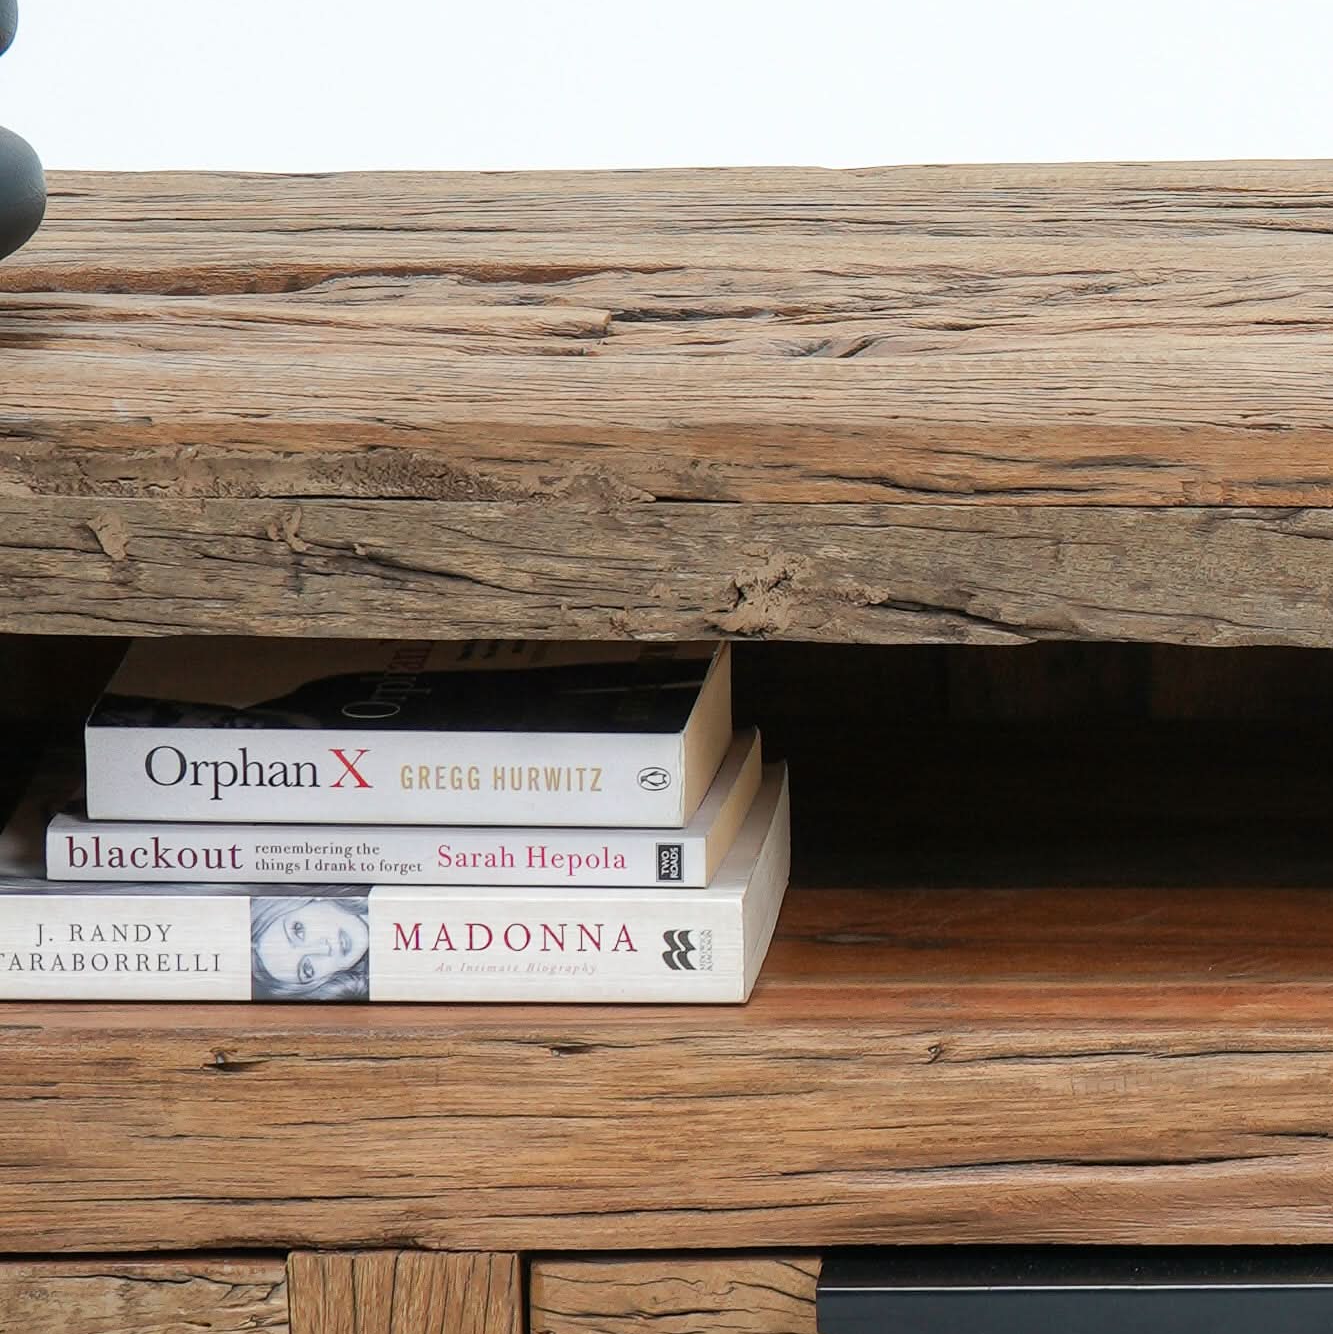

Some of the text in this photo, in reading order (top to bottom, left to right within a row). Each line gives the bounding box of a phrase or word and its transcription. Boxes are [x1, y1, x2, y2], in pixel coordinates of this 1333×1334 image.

[144, 745, 374, 801] Orphan X
[400, 764, 603, 792] GREGG HURWITZ
[65, 836, 244, 870] blackout
[254, 842, 380, 858] remembering the
[437, 844, 628, 876] Sarah Hepola
[660, 850, 670, 876] TWO
[670, 847, 679, 879] ROADS
[255, 858, 423, 875] things I drank to forget
[36, 923, 173, 947] J. RANDY
[392, 922, 639, 953] MADONNA
